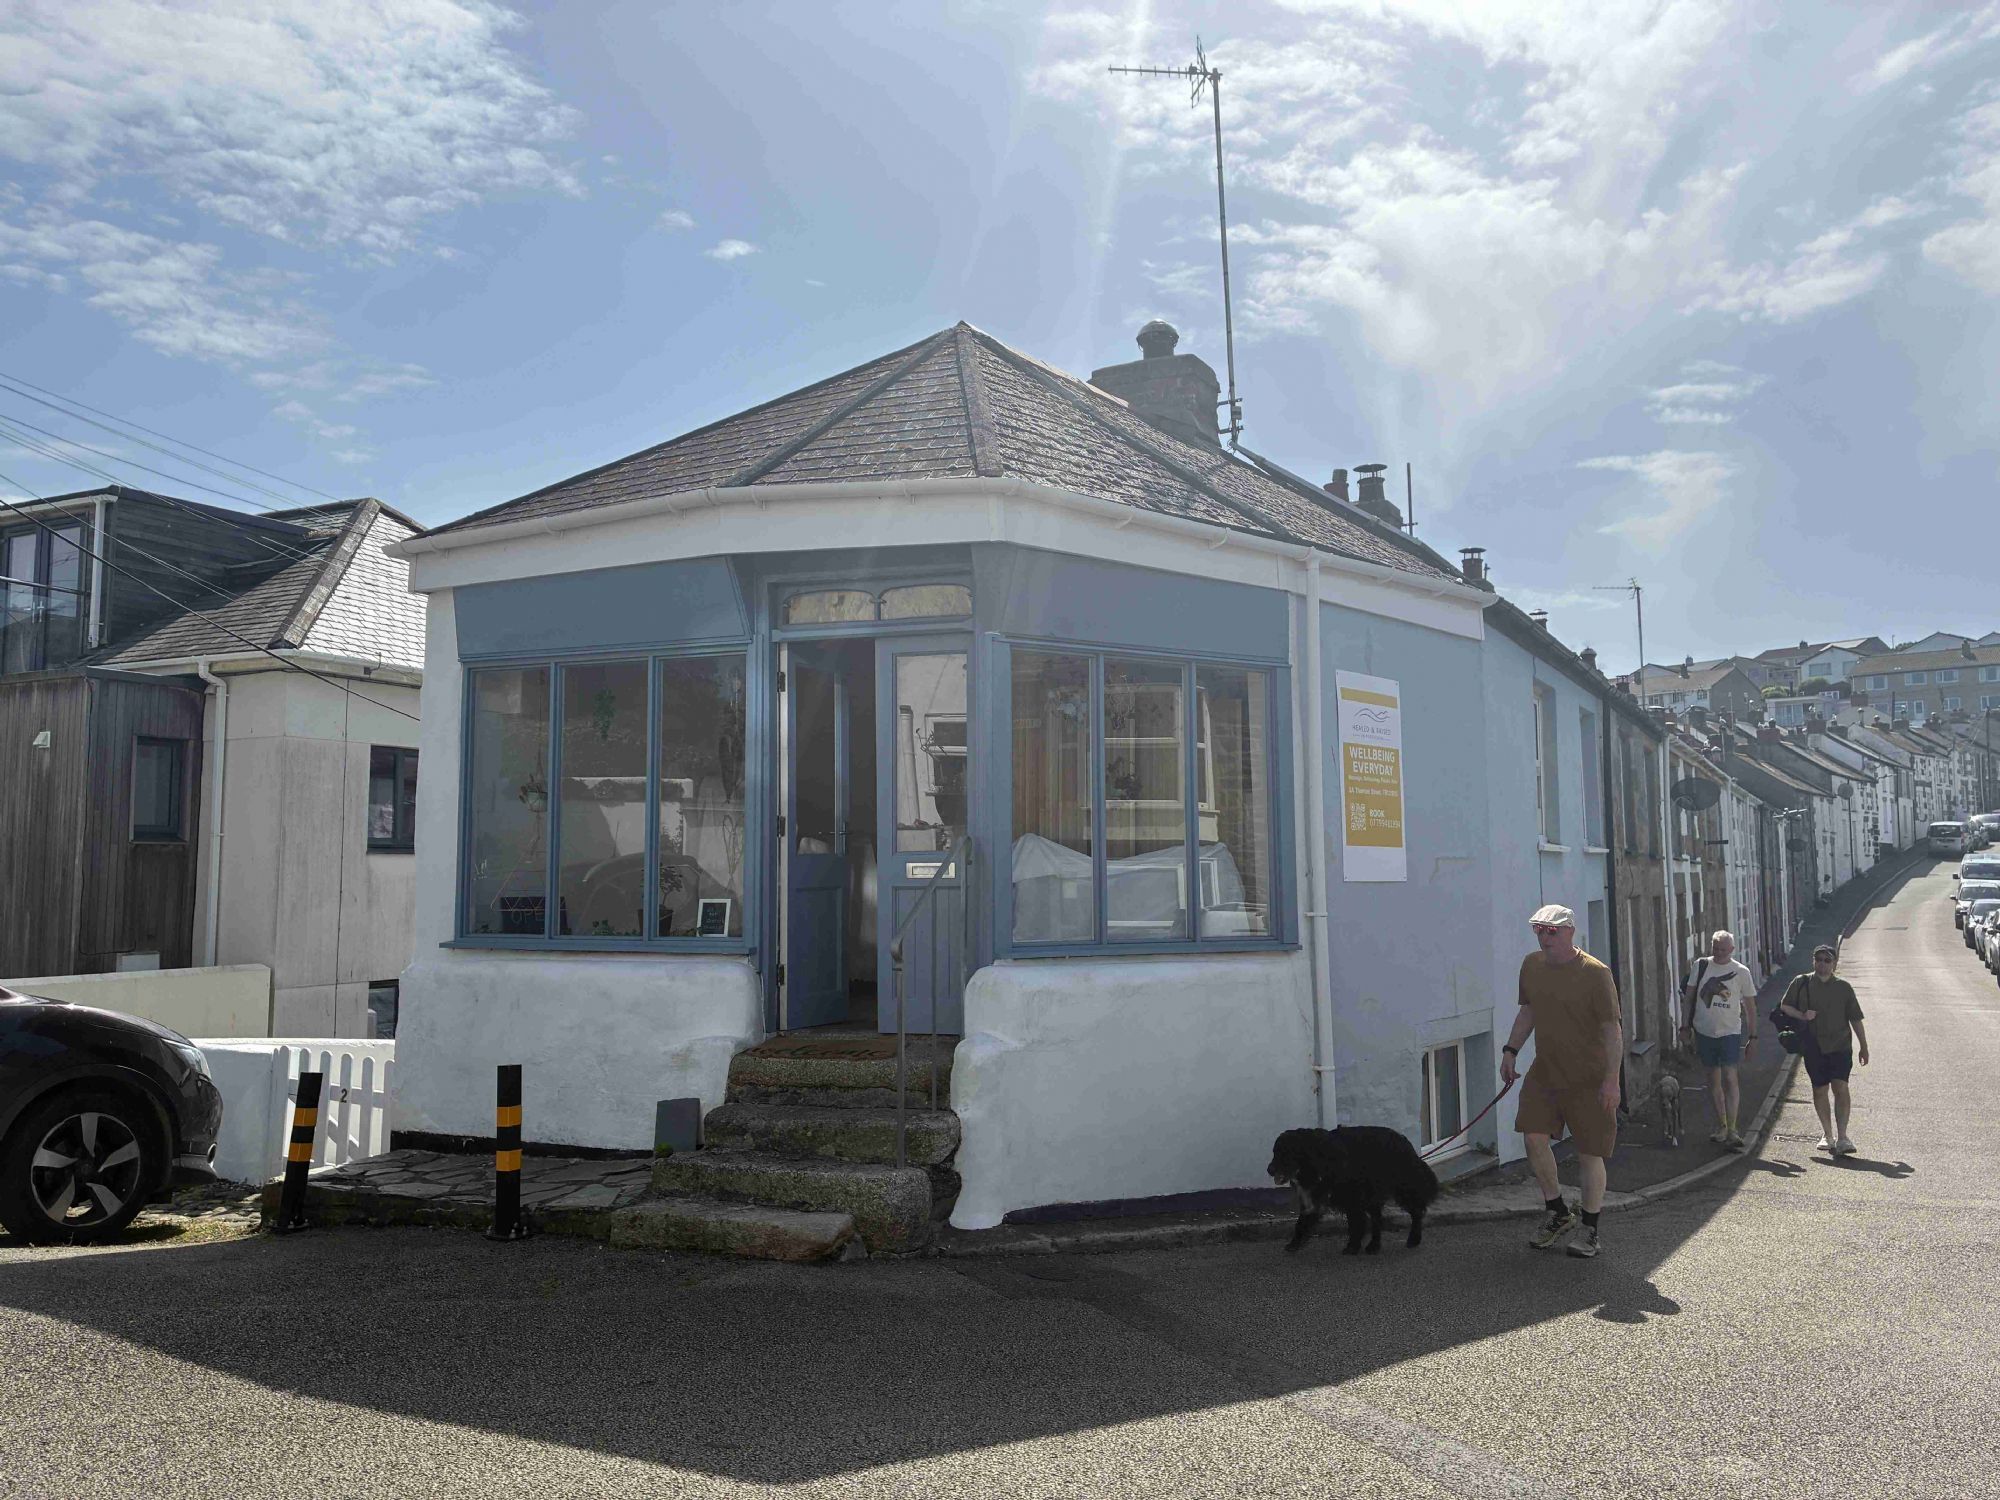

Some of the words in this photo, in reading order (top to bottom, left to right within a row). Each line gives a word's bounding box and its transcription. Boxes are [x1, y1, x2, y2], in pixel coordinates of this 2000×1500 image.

[1349, 745, 1395, 763] WELLBEING
[1352, 761, 1393, 776] EVERYDAY
[1369, 809, 1385, 818] BOOK
[511, 904, 545, 926] OPE
[340, 1088, 348, 1103] 2
